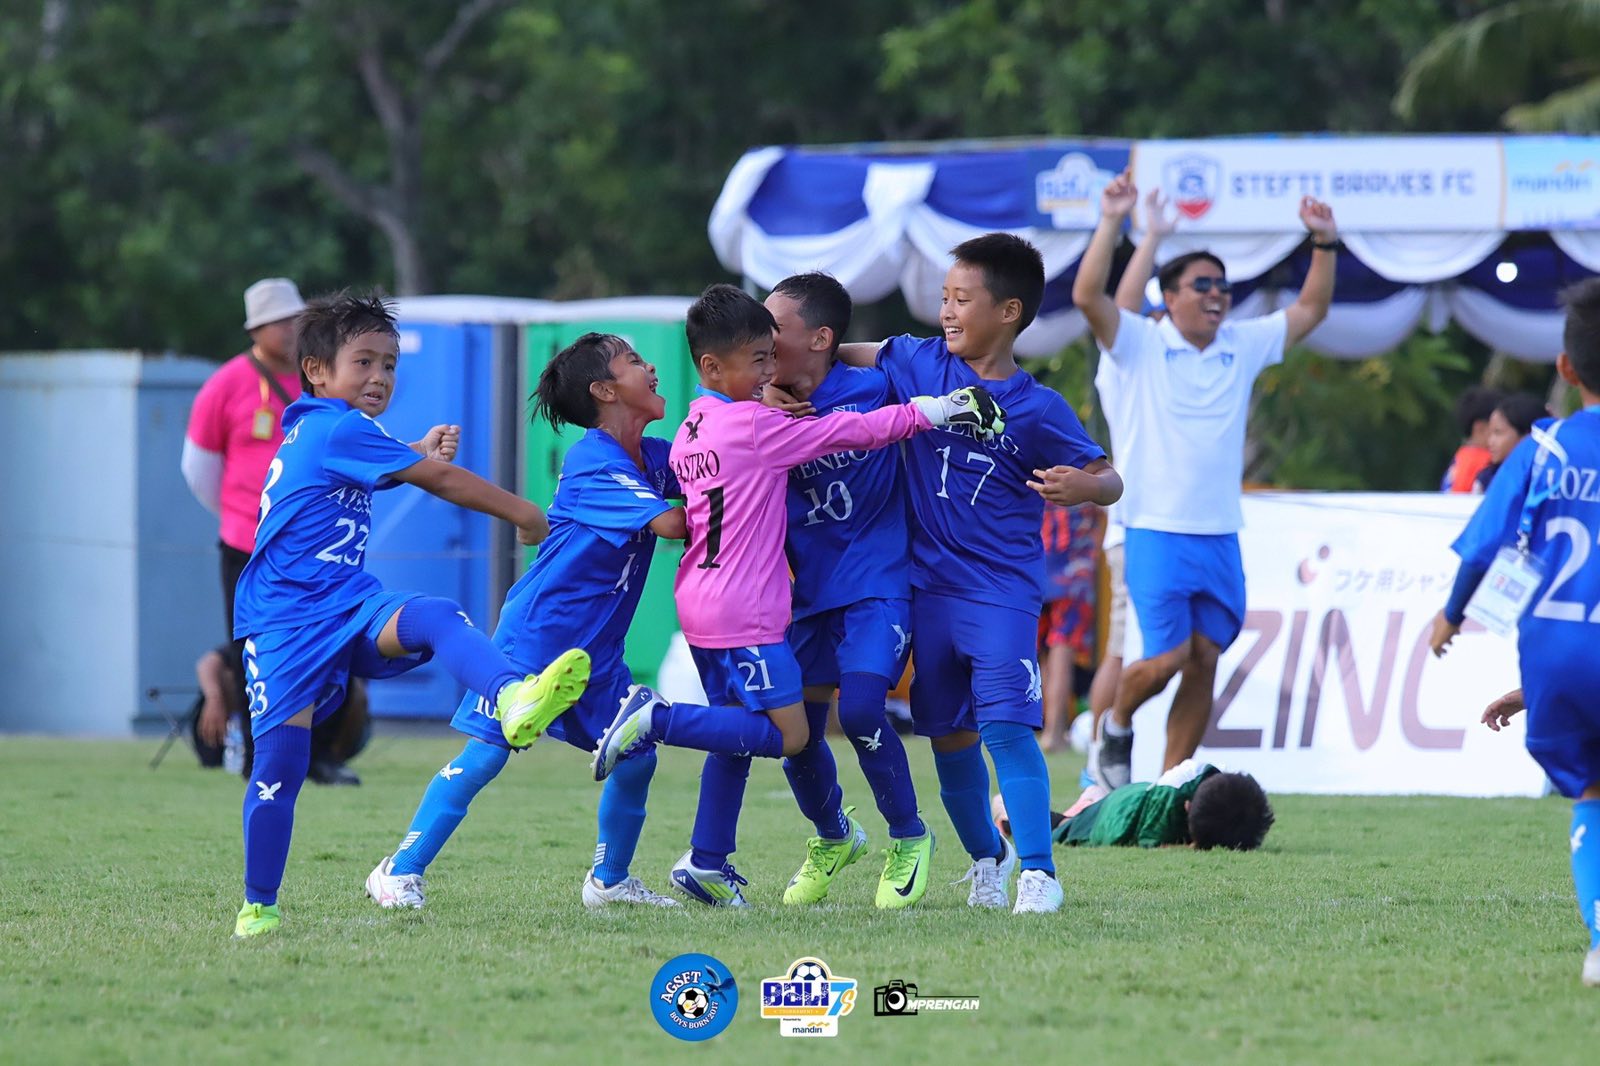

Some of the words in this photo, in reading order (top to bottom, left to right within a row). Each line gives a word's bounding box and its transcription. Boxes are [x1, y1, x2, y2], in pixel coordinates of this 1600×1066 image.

[1332, 171, 1433, 196] BRAVES
[1443, 170, 1475, 195] FC
[936, 446, 996, 505] 17
[804, 481, 853, 526] 10
[315, 517, 370, 566] 23
[1533, 517, 1600, 622] 2
[738, 661, 775, 690] 21
[1200, 608, 1488, 751] ZINC
[245, 682, 268, 717] 23
